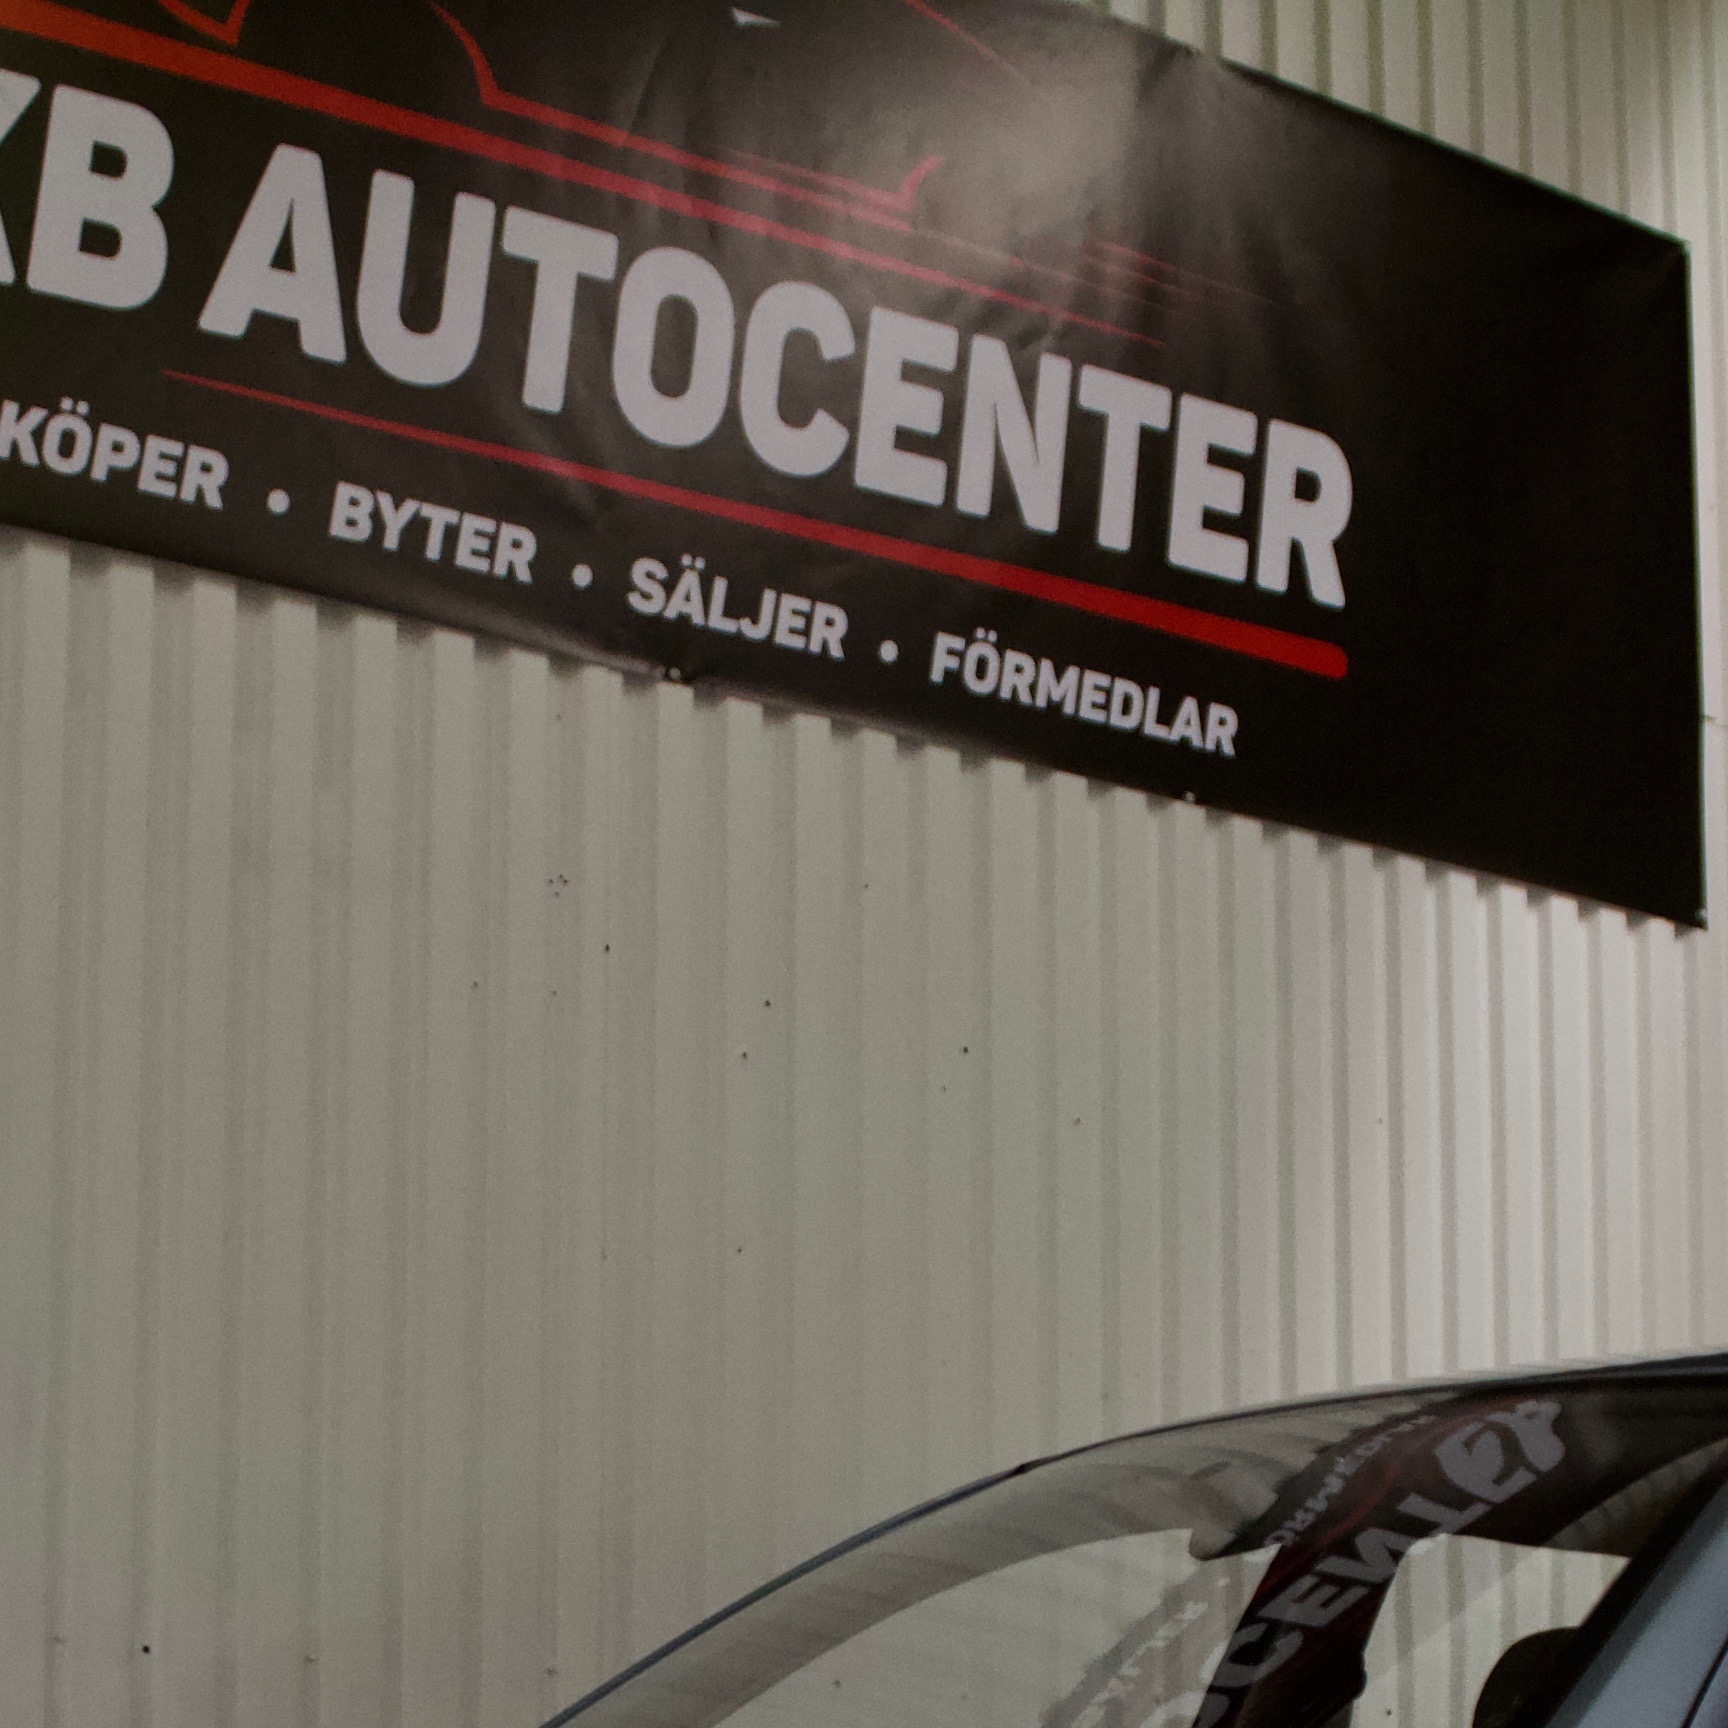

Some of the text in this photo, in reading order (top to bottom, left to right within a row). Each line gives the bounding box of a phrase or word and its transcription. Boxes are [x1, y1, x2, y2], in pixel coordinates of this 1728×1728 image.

[198, 143, 1353, 611] AUTOCENTER
[328, 480, 538, 584] BYTER
[627, 553, 849, 660] SÄLJER
[930, 626, 1239, 758] FÖRMEDLAR
